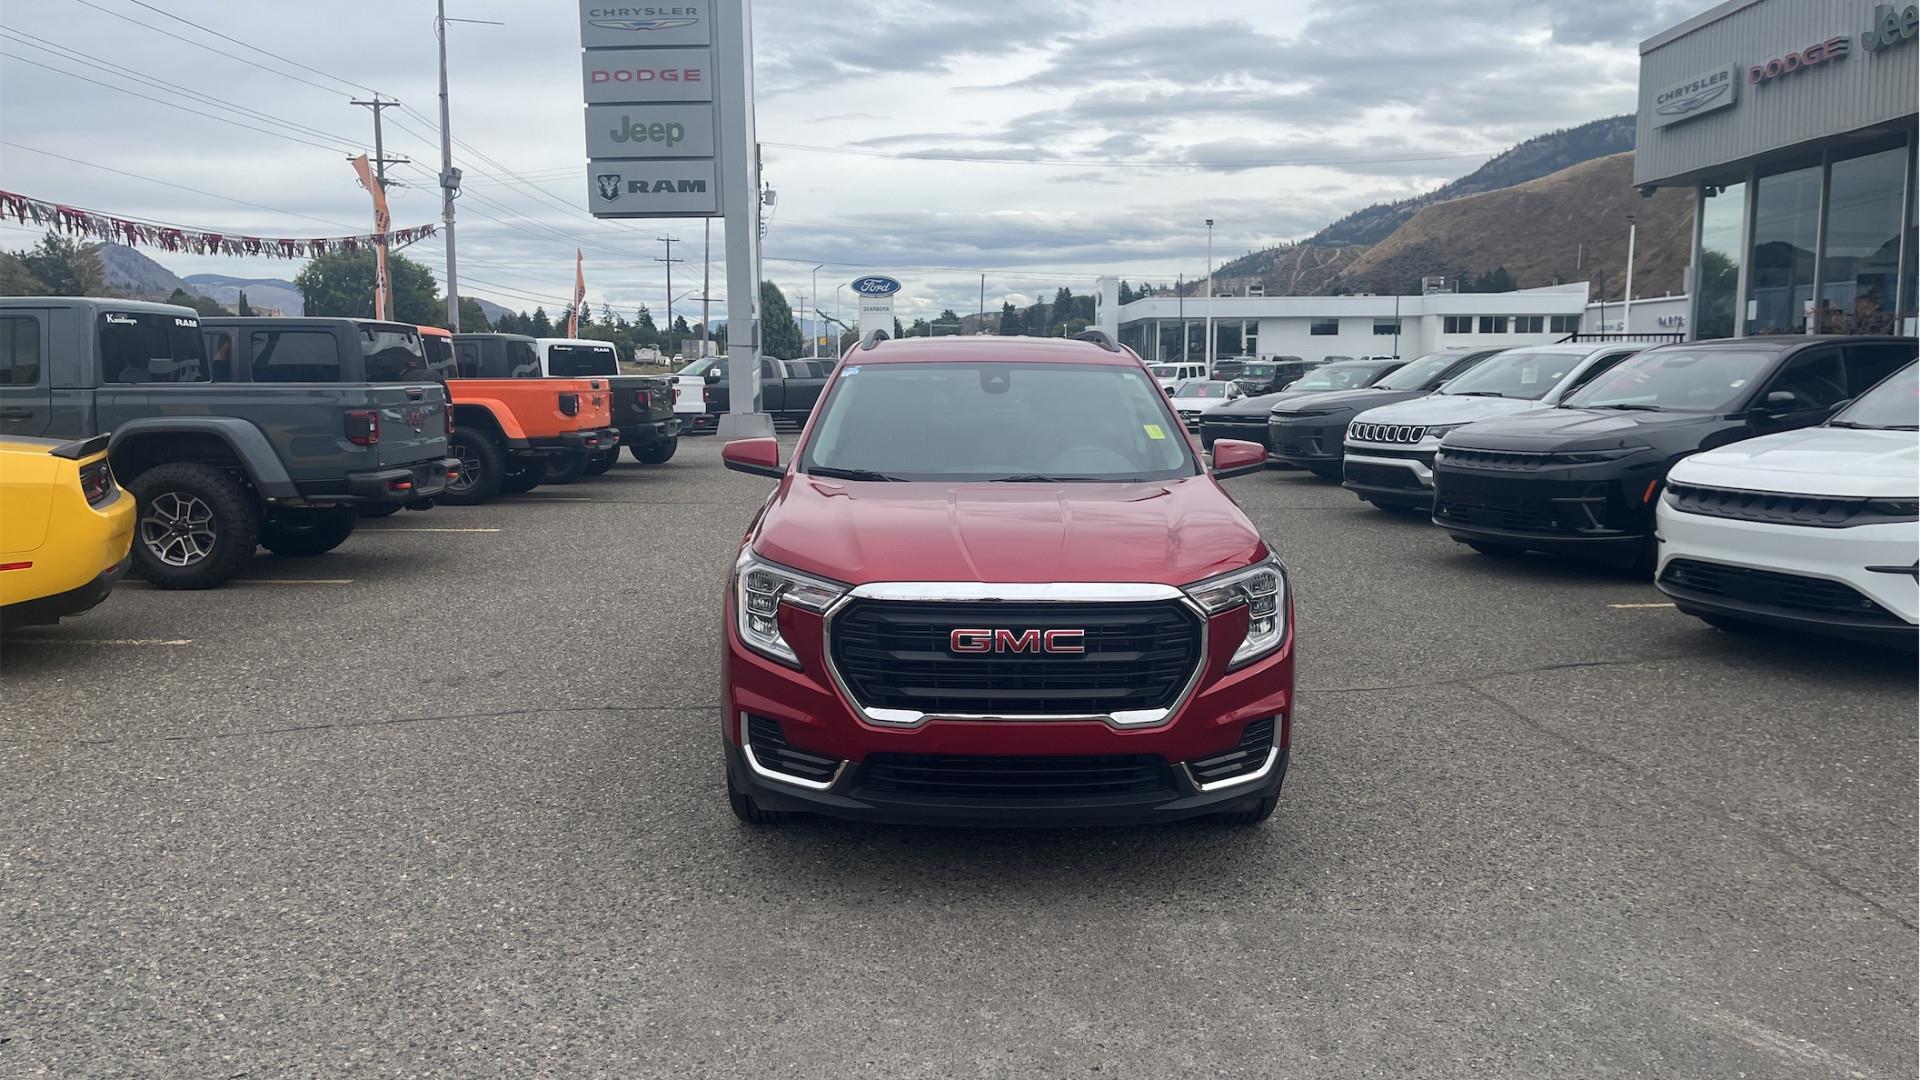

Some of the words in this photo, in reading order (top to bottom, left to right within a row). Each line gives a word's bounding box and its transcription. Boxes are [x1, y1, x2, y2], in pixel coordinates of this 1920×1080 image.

[590, 7, 697, 17] CHRYSLER
[1749, 36, 1850, 84] DODGE
[591, 69, 701, 84] DODGE
[1656, 70, 1729, 105] CHRYSLER
[609, 115, 685, 147] Jeep
[627, 179, 707, 194] RAM
[860, 278, 891, 292] Ford
[174, 318, 198, 328] RAM
[950, 628, 1085, 654] GMC
